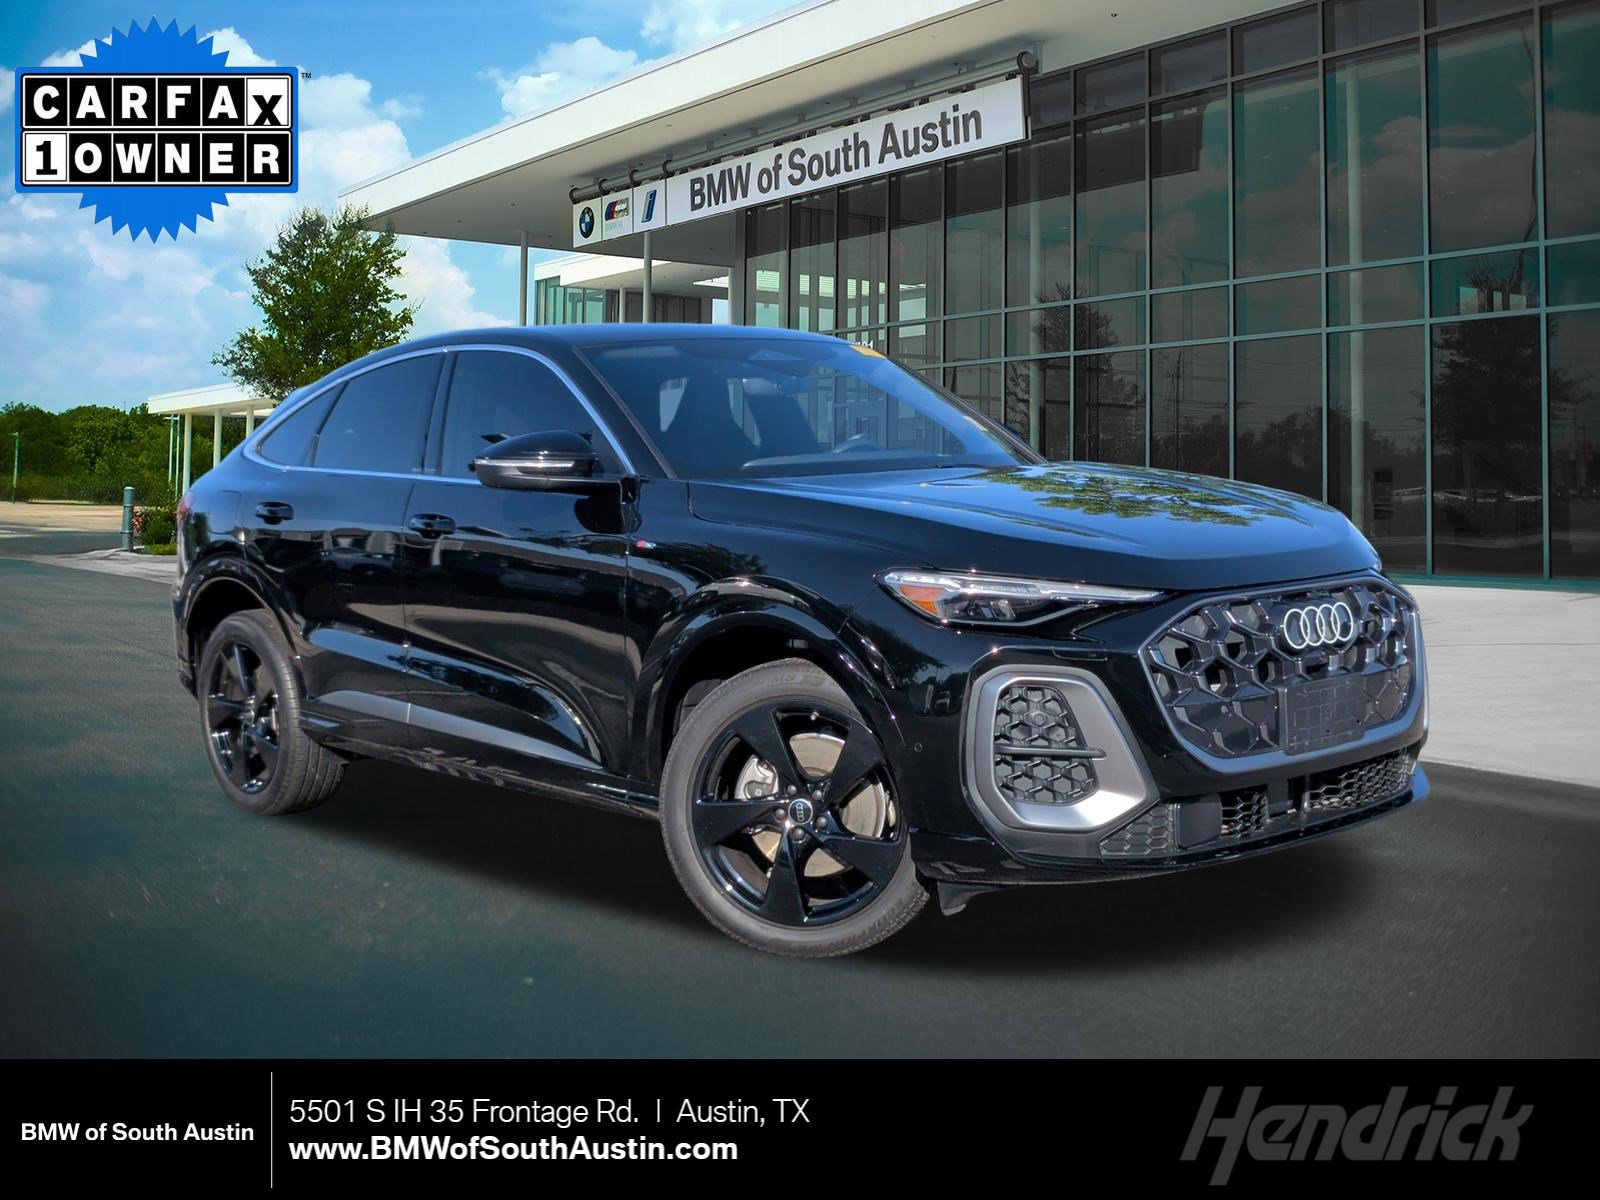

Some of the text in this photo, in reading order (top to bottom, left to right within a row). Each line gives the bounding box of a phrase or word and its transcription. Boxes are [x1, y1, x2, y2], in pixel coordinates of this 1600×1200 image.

[690, 162, 751, 212] BMW
[757, 153, 783, 194] of
[787, 131, 870, 186] South
[878, 103, 982, 164] Austin
